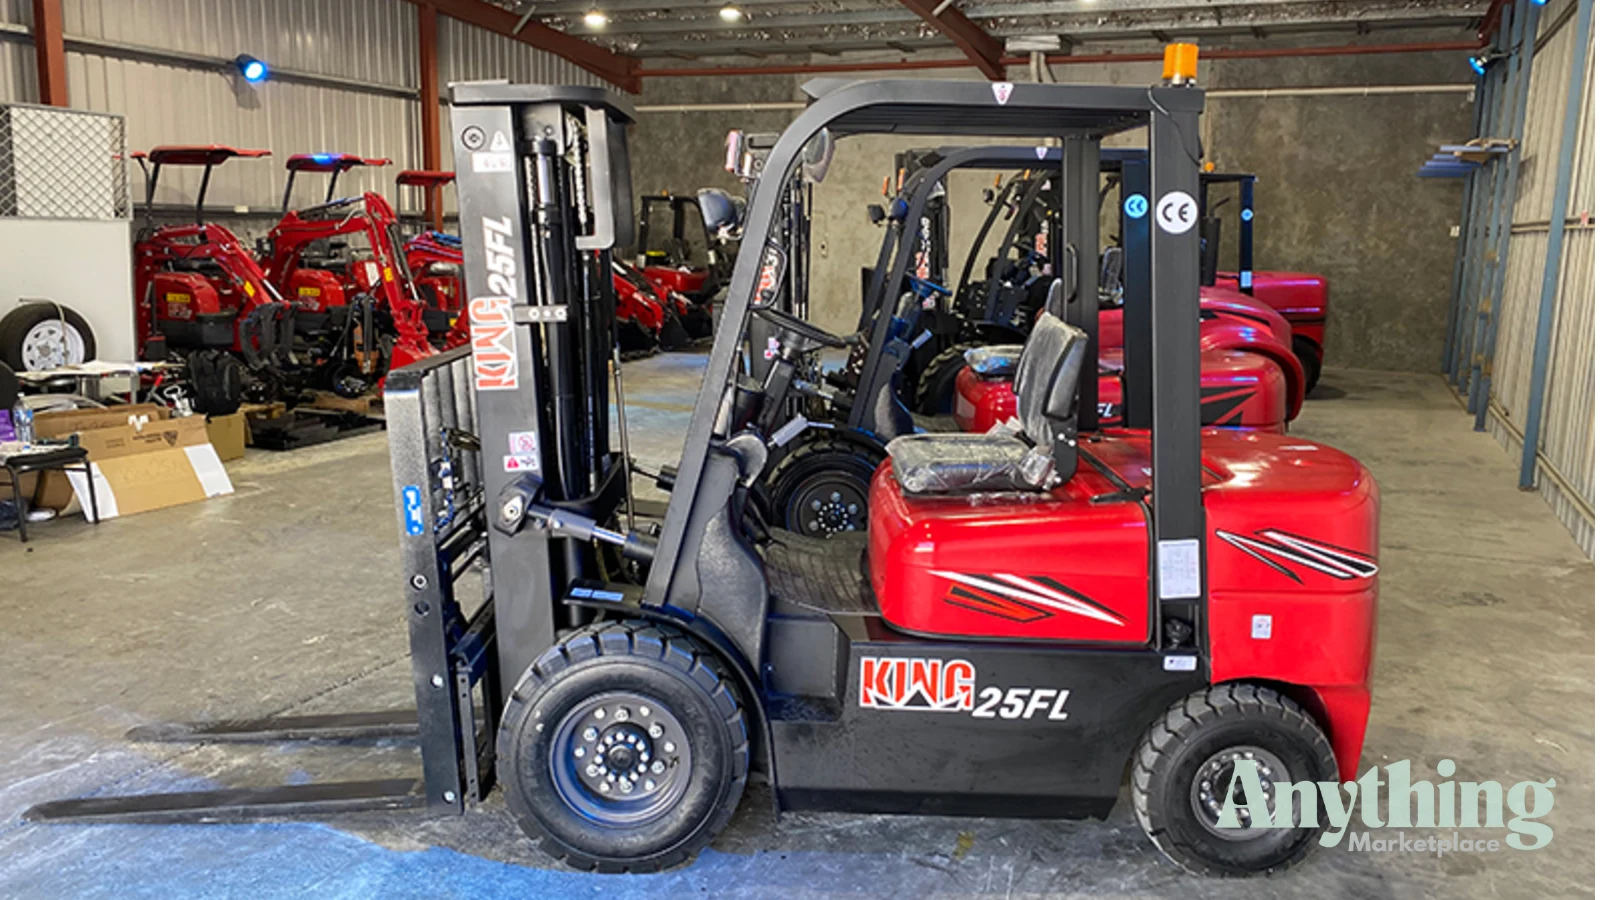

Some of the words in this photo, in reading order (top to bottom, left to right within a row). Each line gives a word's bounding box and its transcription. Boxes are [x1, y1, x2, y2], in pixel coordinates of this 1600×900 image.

[1162, 203, 1190, 223] CE
[482, 216, 517, 298] 25FL
[468, 296, 519, 391] KING
[859, 656, 976, 712] KING
[972, 686, 1070, 720] 25FL
